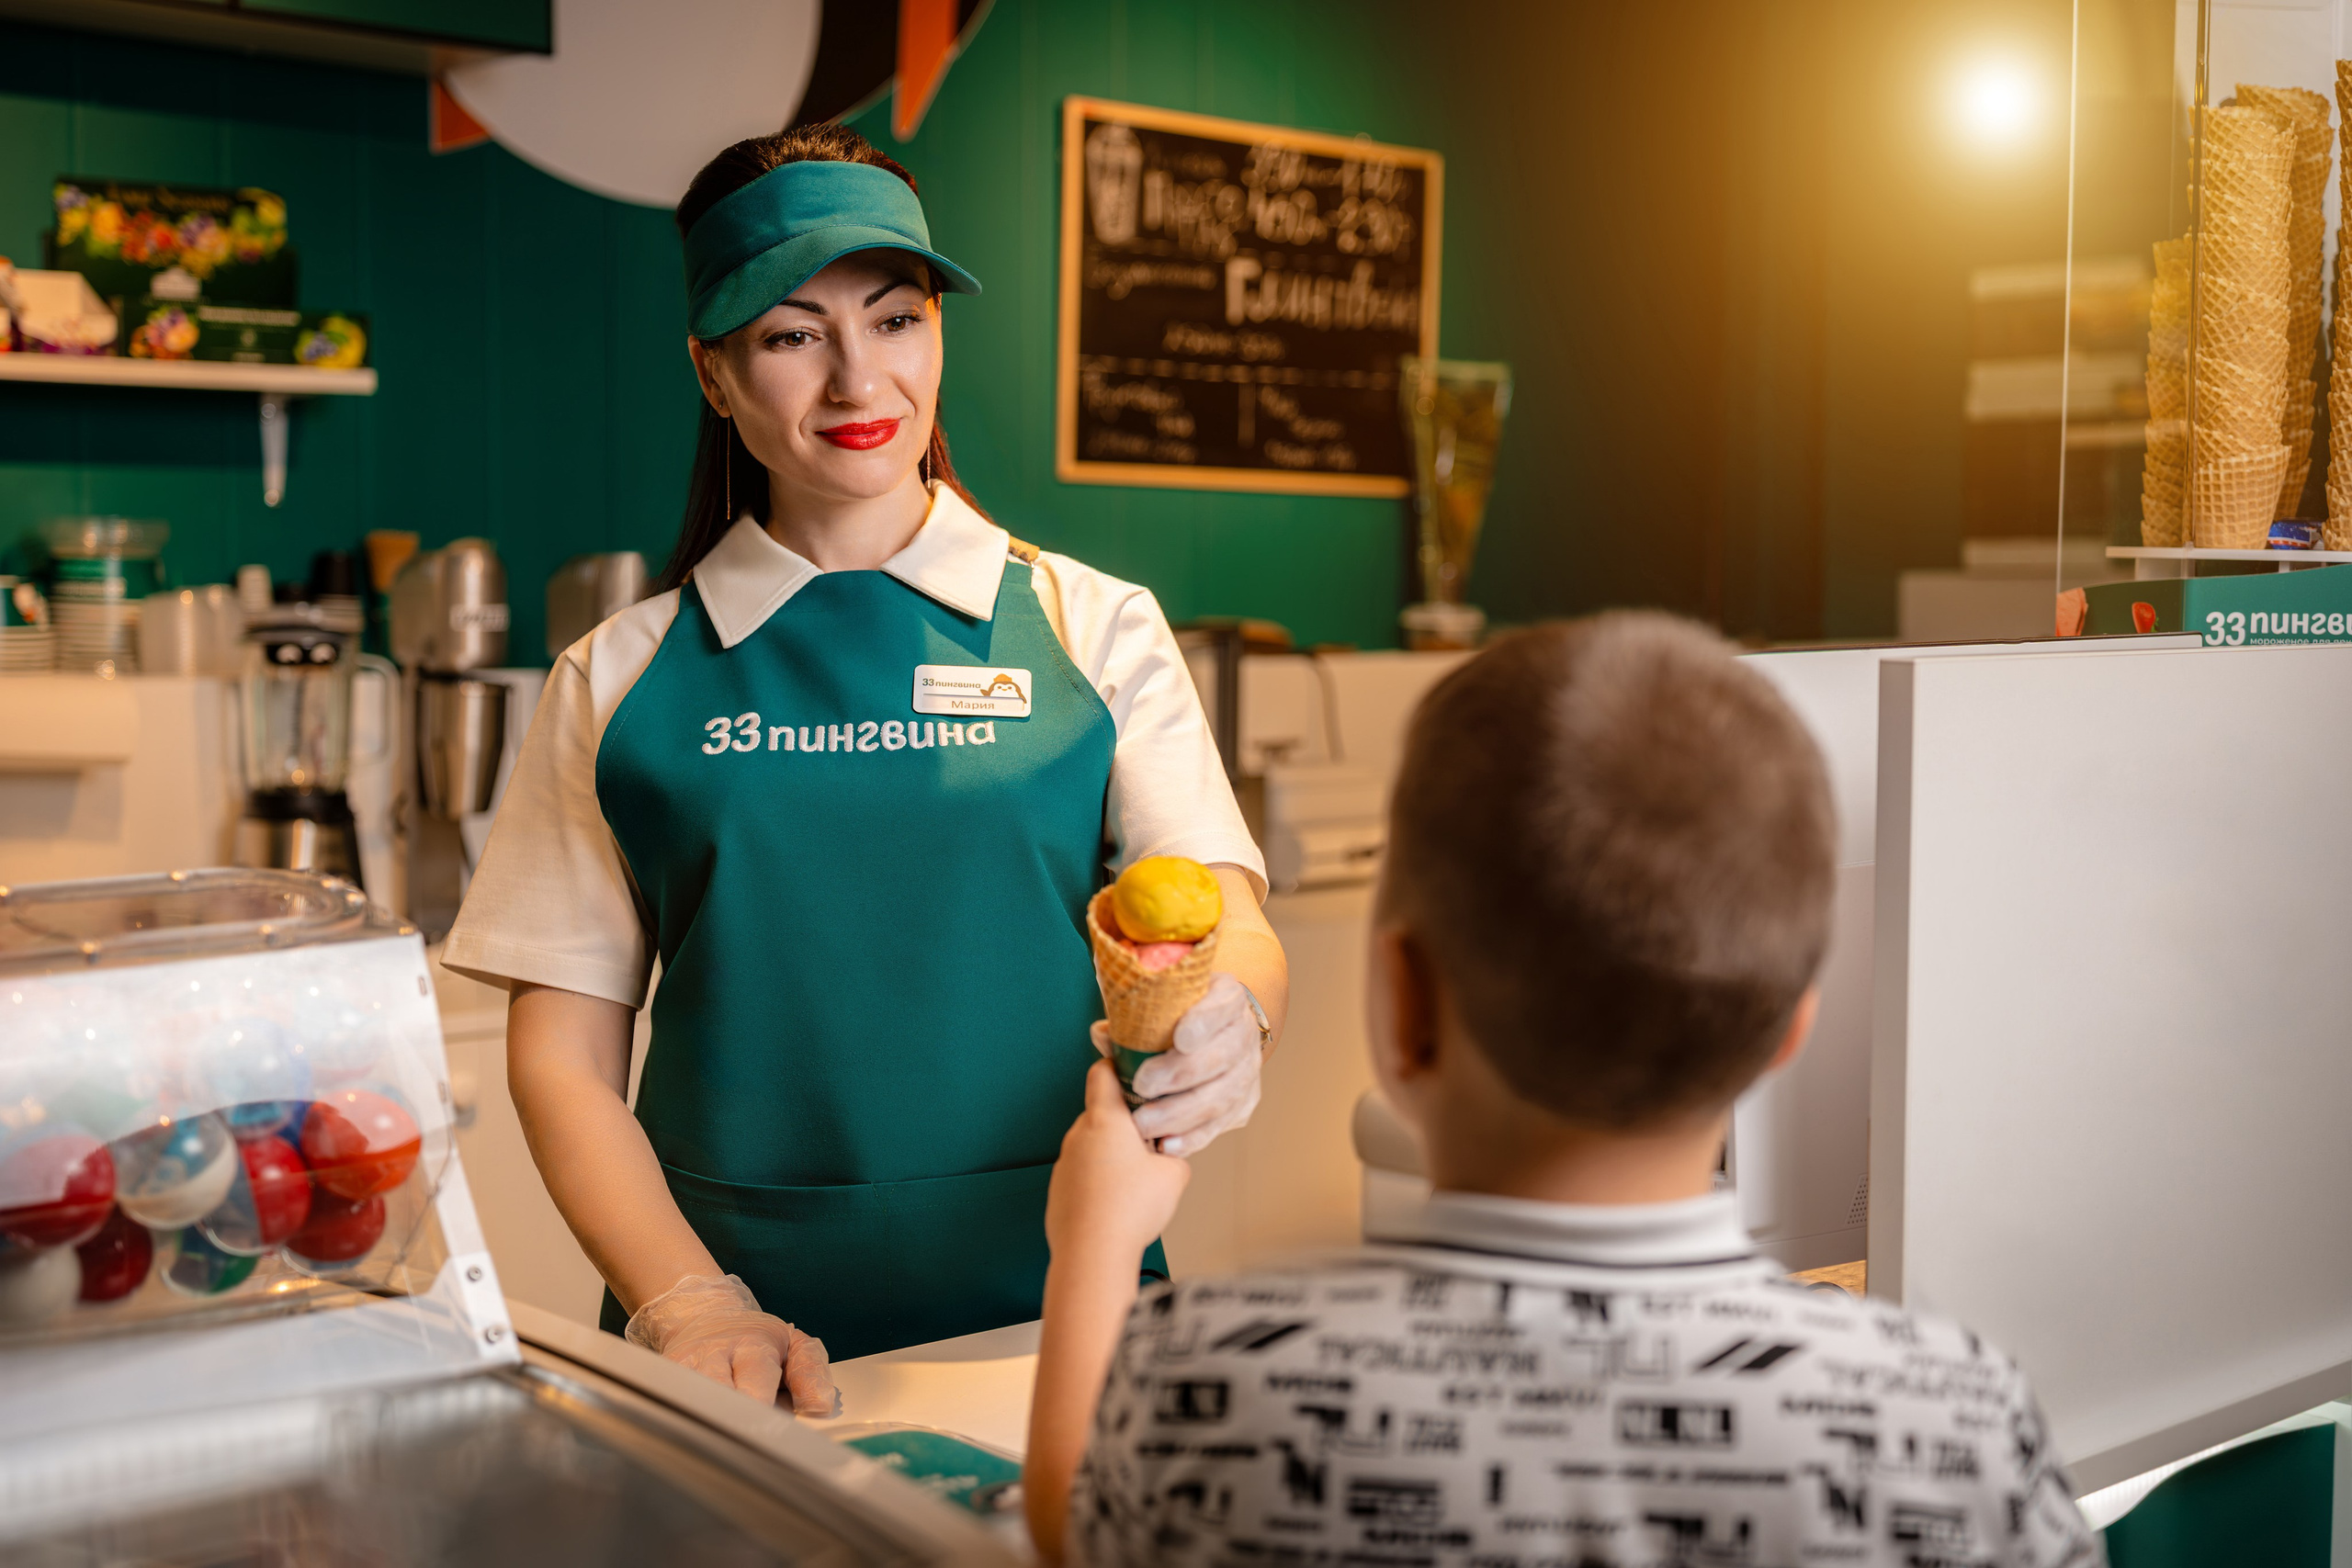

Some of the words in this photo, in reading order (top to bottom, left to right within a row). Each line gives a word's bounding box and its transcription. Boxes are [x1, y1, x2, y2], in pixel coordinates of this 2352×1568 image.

[2204, 611, 2246, 646] 33
[922, 678, 934, 687] 33
[935, 680, 981, 689] пингвина
[951, 700, 995, 710] Мария
[702, 712, 762, 755] 33
[768, 719, 997, 753] пингвина
